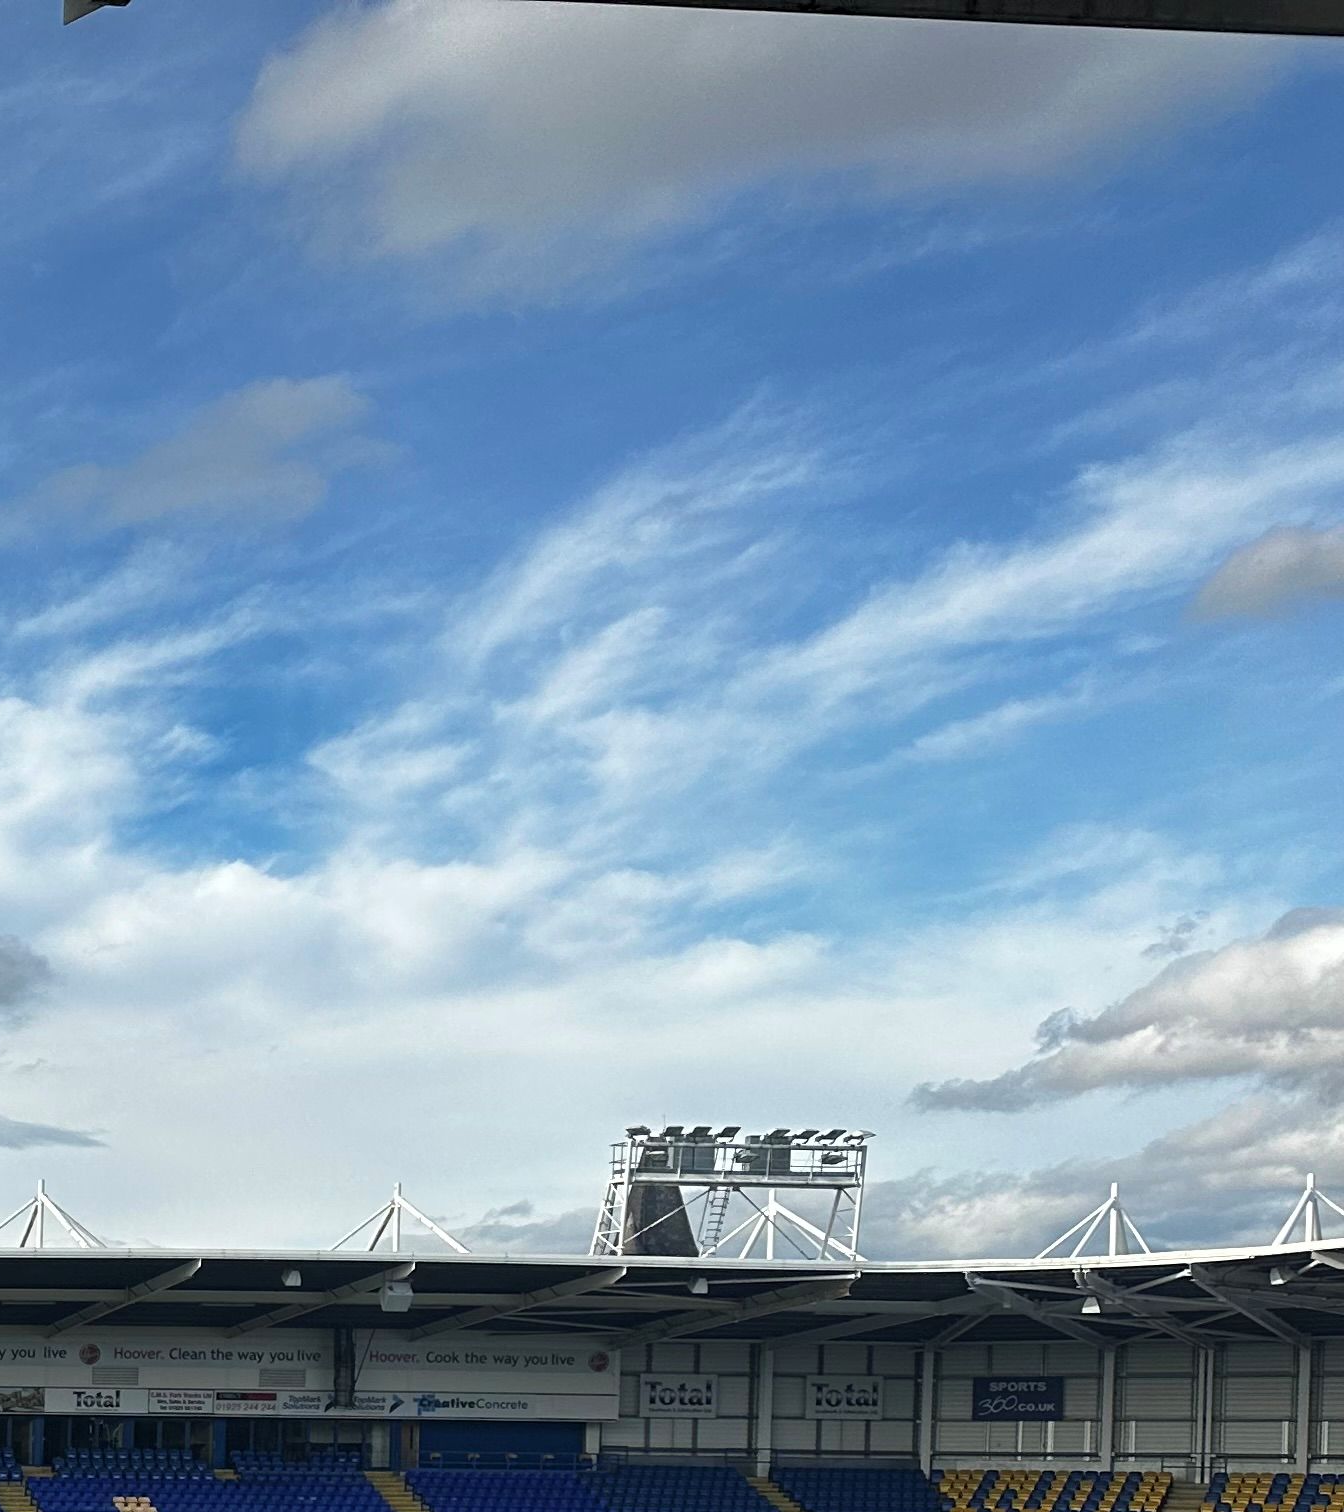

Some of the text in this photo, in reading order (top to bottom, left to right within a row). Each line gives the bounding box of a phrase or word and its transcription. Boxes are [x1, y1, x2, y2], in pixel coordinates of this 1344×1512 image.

[11, 1348, 36, 1360] you
[43, 1346, 67, 1359] live
[169, 1347, 206, 1361] Clean
[210, 1348, 233, 1361] the
[237, 1351, 264, 1363] way
[269, 1351, 294, 1363] you
[297, 1349, 321, 1362] live
[426, 1351, 460, 1364] Cook
[465, 1352, 487, 1364] the
[493, 1355, 519, 1367] way
[524, 1355, 548, 1367] you
[552, 1353, 575, 1366] live
[645, 1380, 713, 1406] Total
[811, 1382, 879, 1407] Total
[989, 1381, 1048, 1392] SPORTS
[72, 1390, 120, 1408] Total
